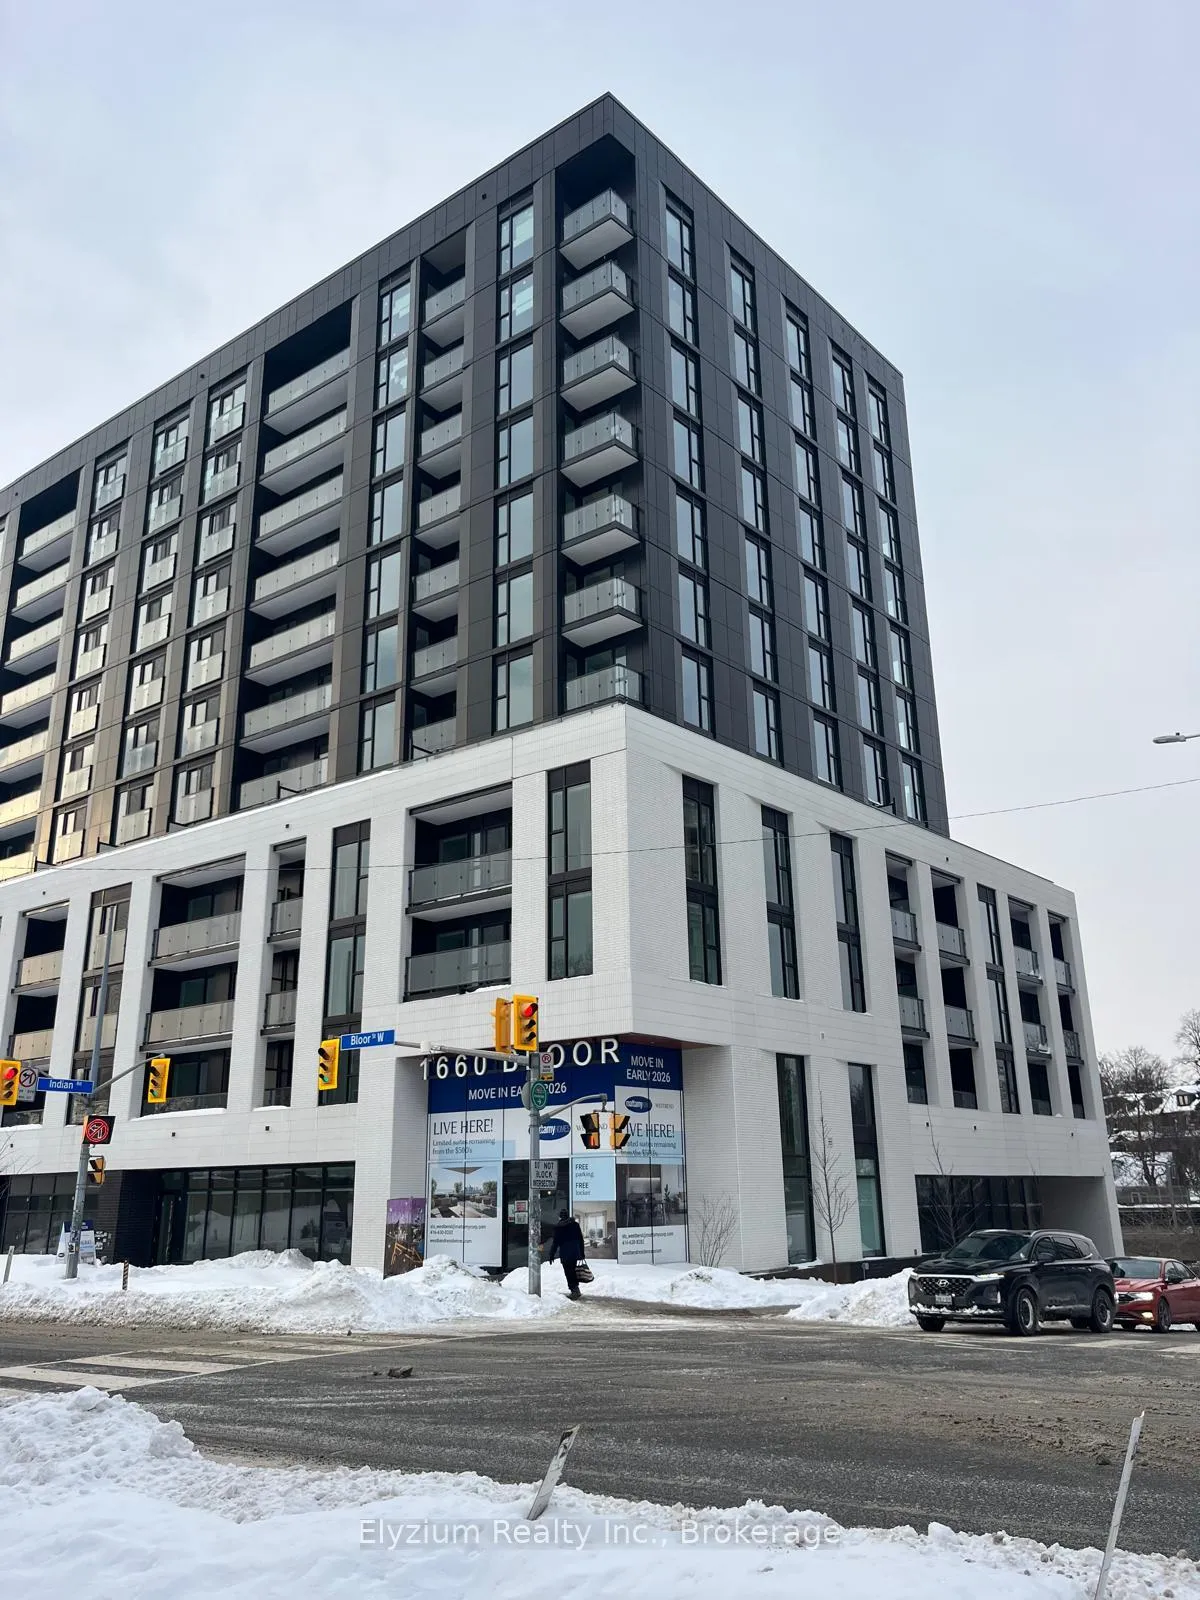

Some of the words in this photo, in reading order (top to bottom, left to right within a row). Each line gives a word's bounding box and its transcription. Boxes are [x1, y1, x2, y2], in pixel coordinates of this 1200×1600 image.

[350, 1035, 371, 1046] Bloor
[377, 1032, 385, 1043] W
[420, 1054, 486, 1080] 1660
[630, 1056, 654, 1068] MOVE
[655, 1058, 664, 1068] IN
[626, 1069, 651, 1081] EARLY
[652, 1071, 671, 1083] 2026
[49, 1080, 74, 1089] Indian
[468, 1087, 497, 1100] MOVE
[498, 1086, 508, 1098] IN
[433, 1120, 457, 1135] LIVE
[460, 1118, 494, 1134] HERE!
[626, 1122, 643, 1137] IVE
[645, 1123, 675, 1138] HERE!
[543, 1161, 554, 1170] NOT
[535, 1170, 553, 1179] BLOCK
